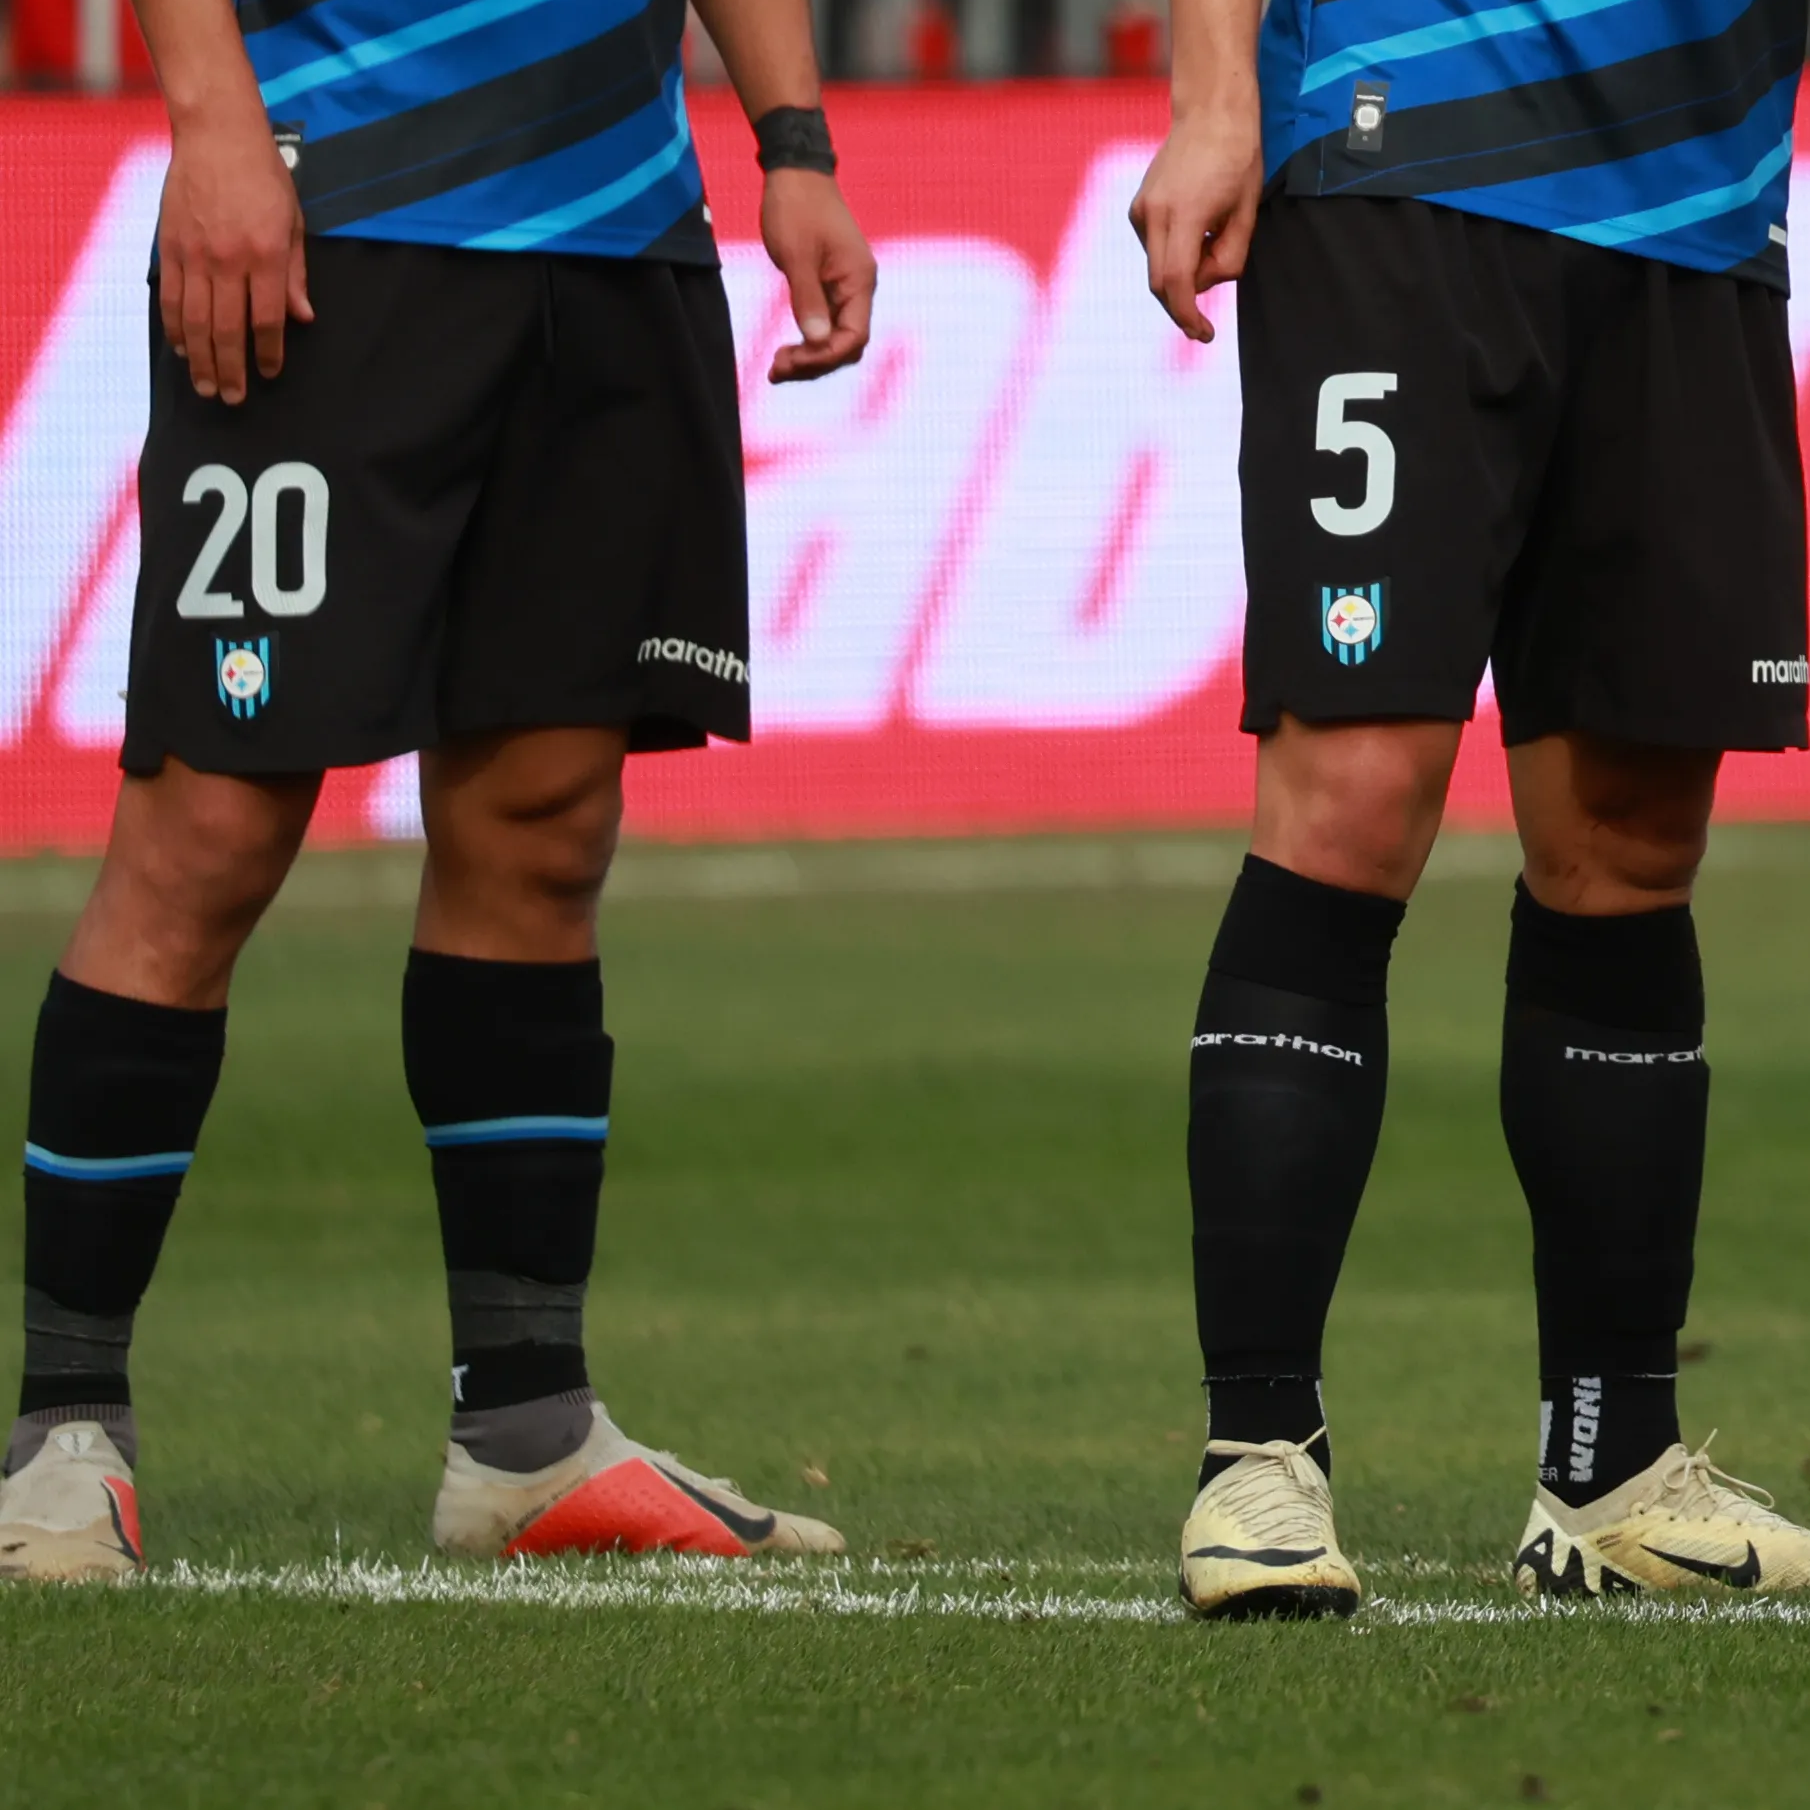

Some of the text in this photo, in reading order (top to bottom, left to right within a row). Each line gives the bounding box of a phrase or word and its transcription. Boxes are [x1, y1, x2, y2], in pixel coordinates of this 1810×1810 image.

[1310, 372, 1398, 536] 5
[176, 462, 329, 617] 20
[638, 637, 750, 684] marath
[1752, 654, 1809, 684] marath
